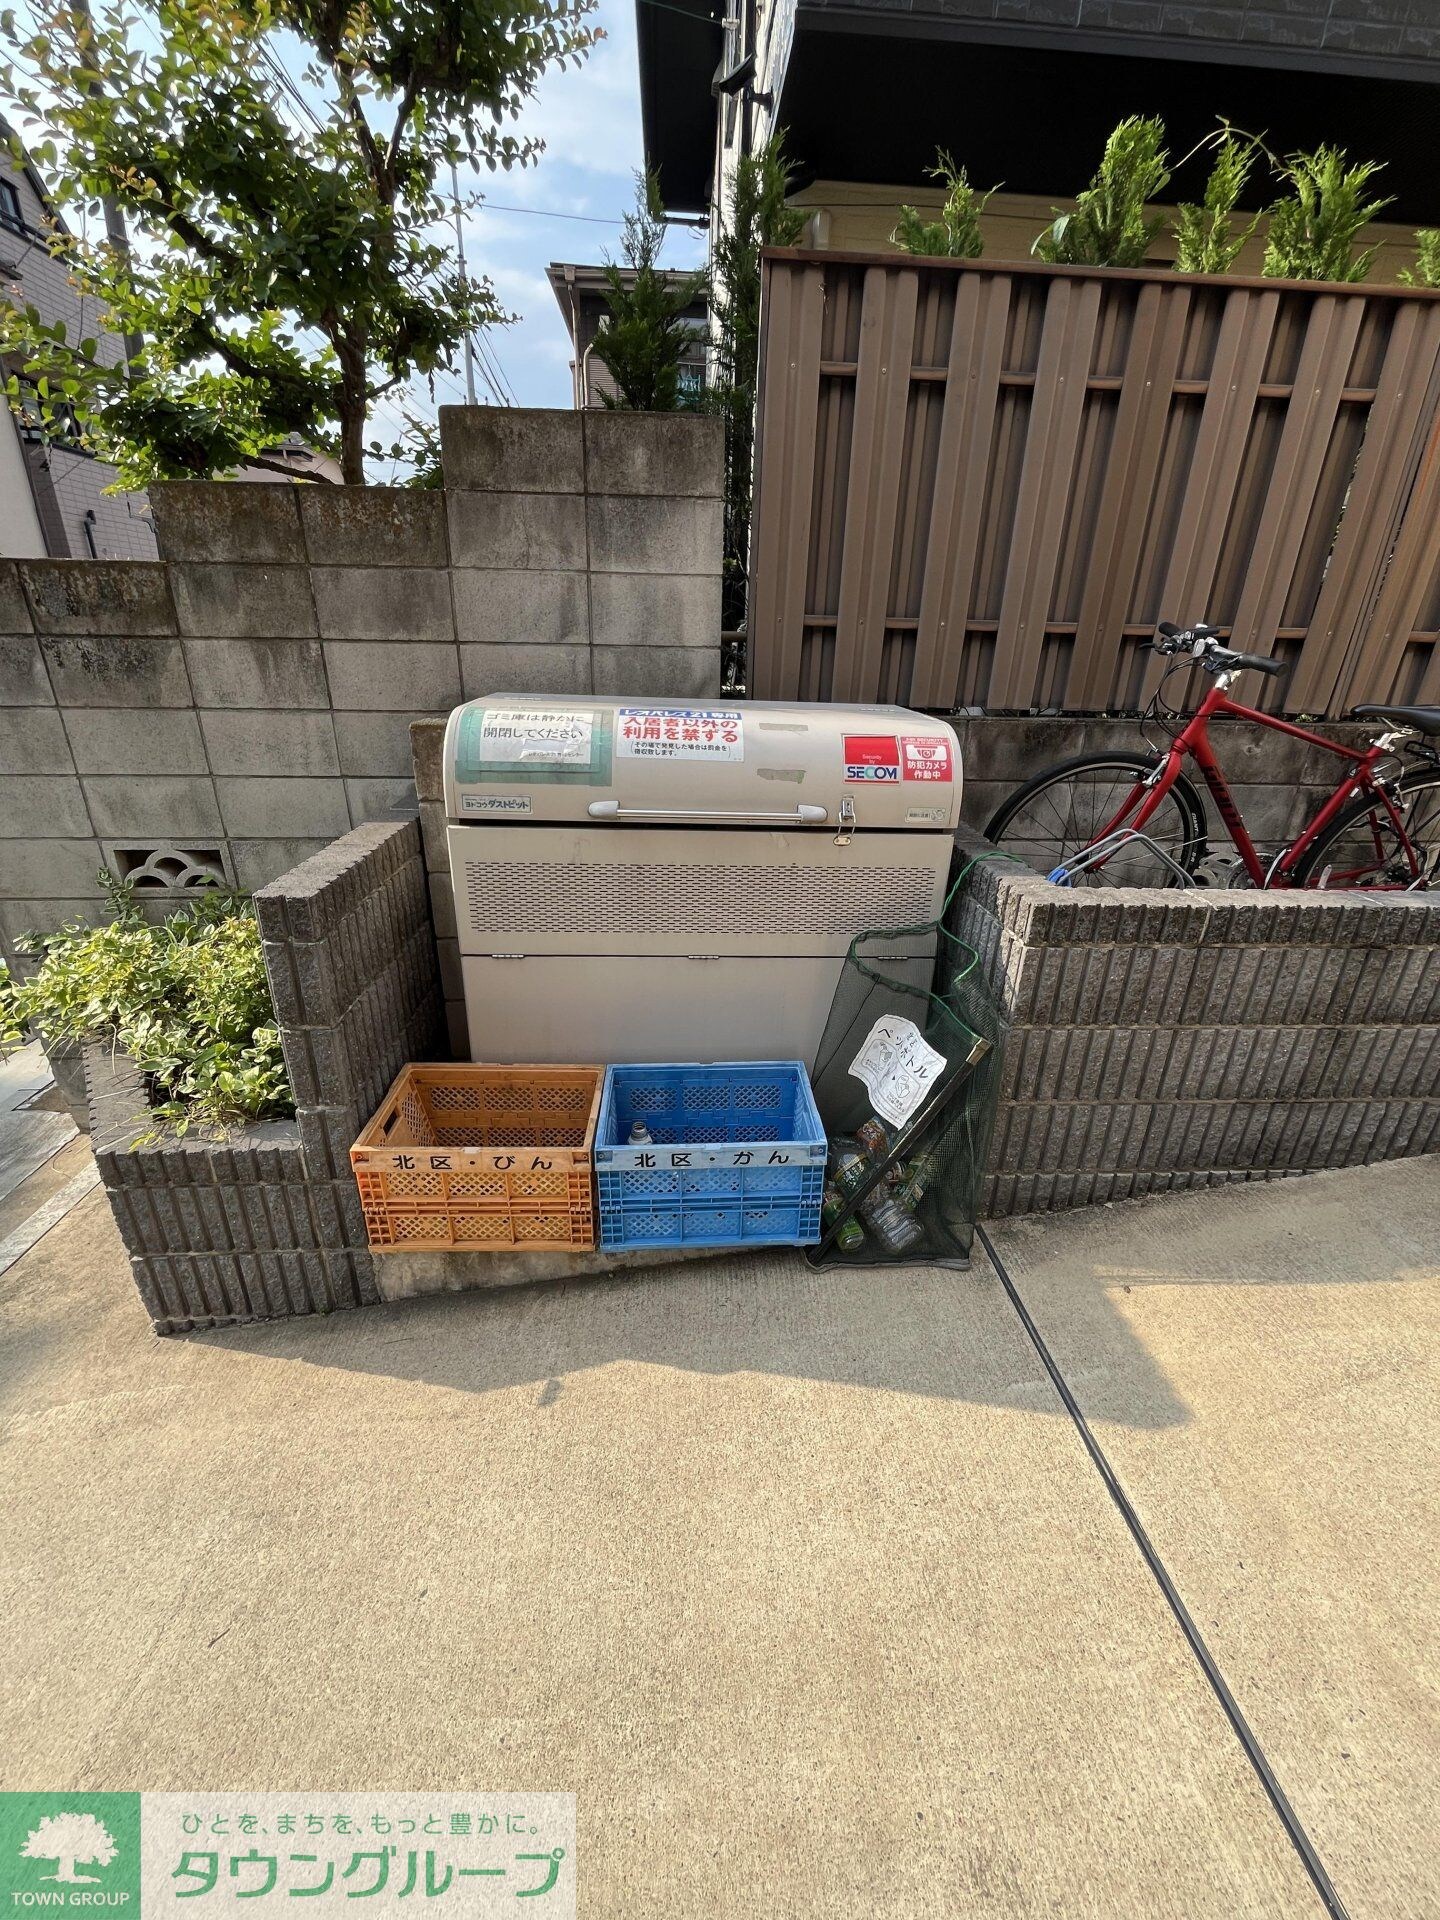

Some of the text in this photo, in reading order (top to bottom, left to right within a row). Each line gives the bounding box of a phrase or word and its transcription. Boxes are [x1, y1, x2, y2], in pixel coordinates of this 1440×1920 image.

[486, 713, 584, 722] ゴミ庫は静かに
[624, 716, 738, 729] 入居者以外の
[483, 727, 583, 739] 開閉してください
[623, 725, 738, 743] 利用を禁ずる
[907, 760, 947, 770] 防犯カメラ
[847, 766, 897, 780] SECOM
[913, 770, 941, 779] 作動中
[392, 1154, 553, 1170] 北区・びん
[634, 1150, 790, 1168] 北区・かん
